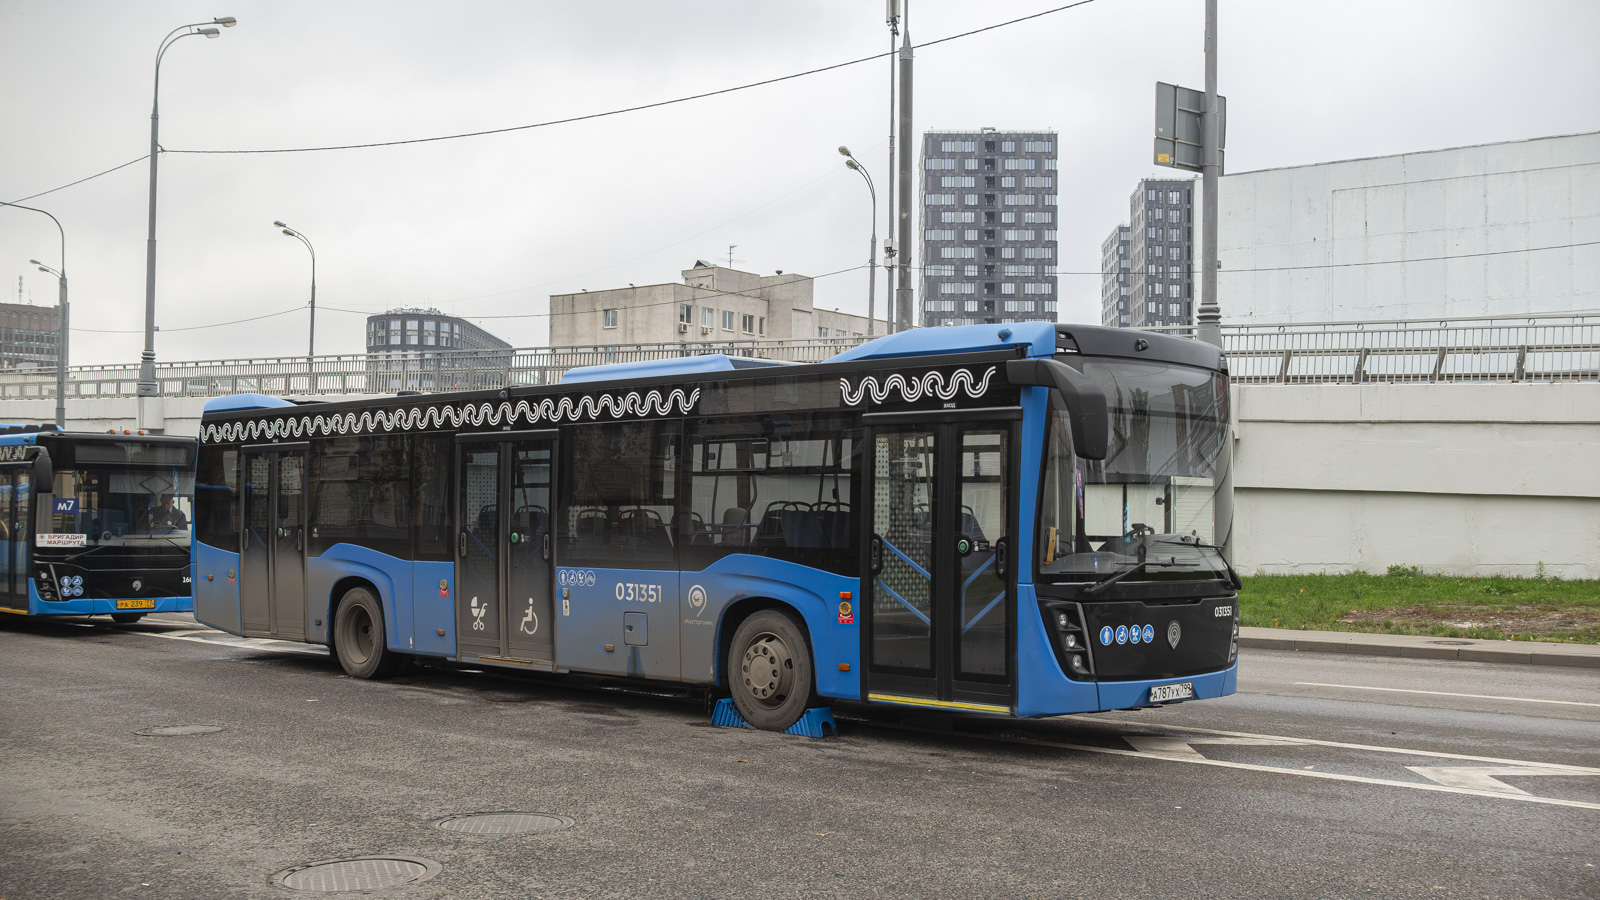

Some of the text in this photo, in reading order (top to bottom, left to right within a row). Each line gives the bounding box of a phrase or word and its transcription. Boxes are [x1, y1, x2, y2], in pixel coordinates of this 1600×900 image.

[615, 582, 662, 603] 031351
[131, 600, 143, 608] 239
[1180, 683, 1191, 693] 799
